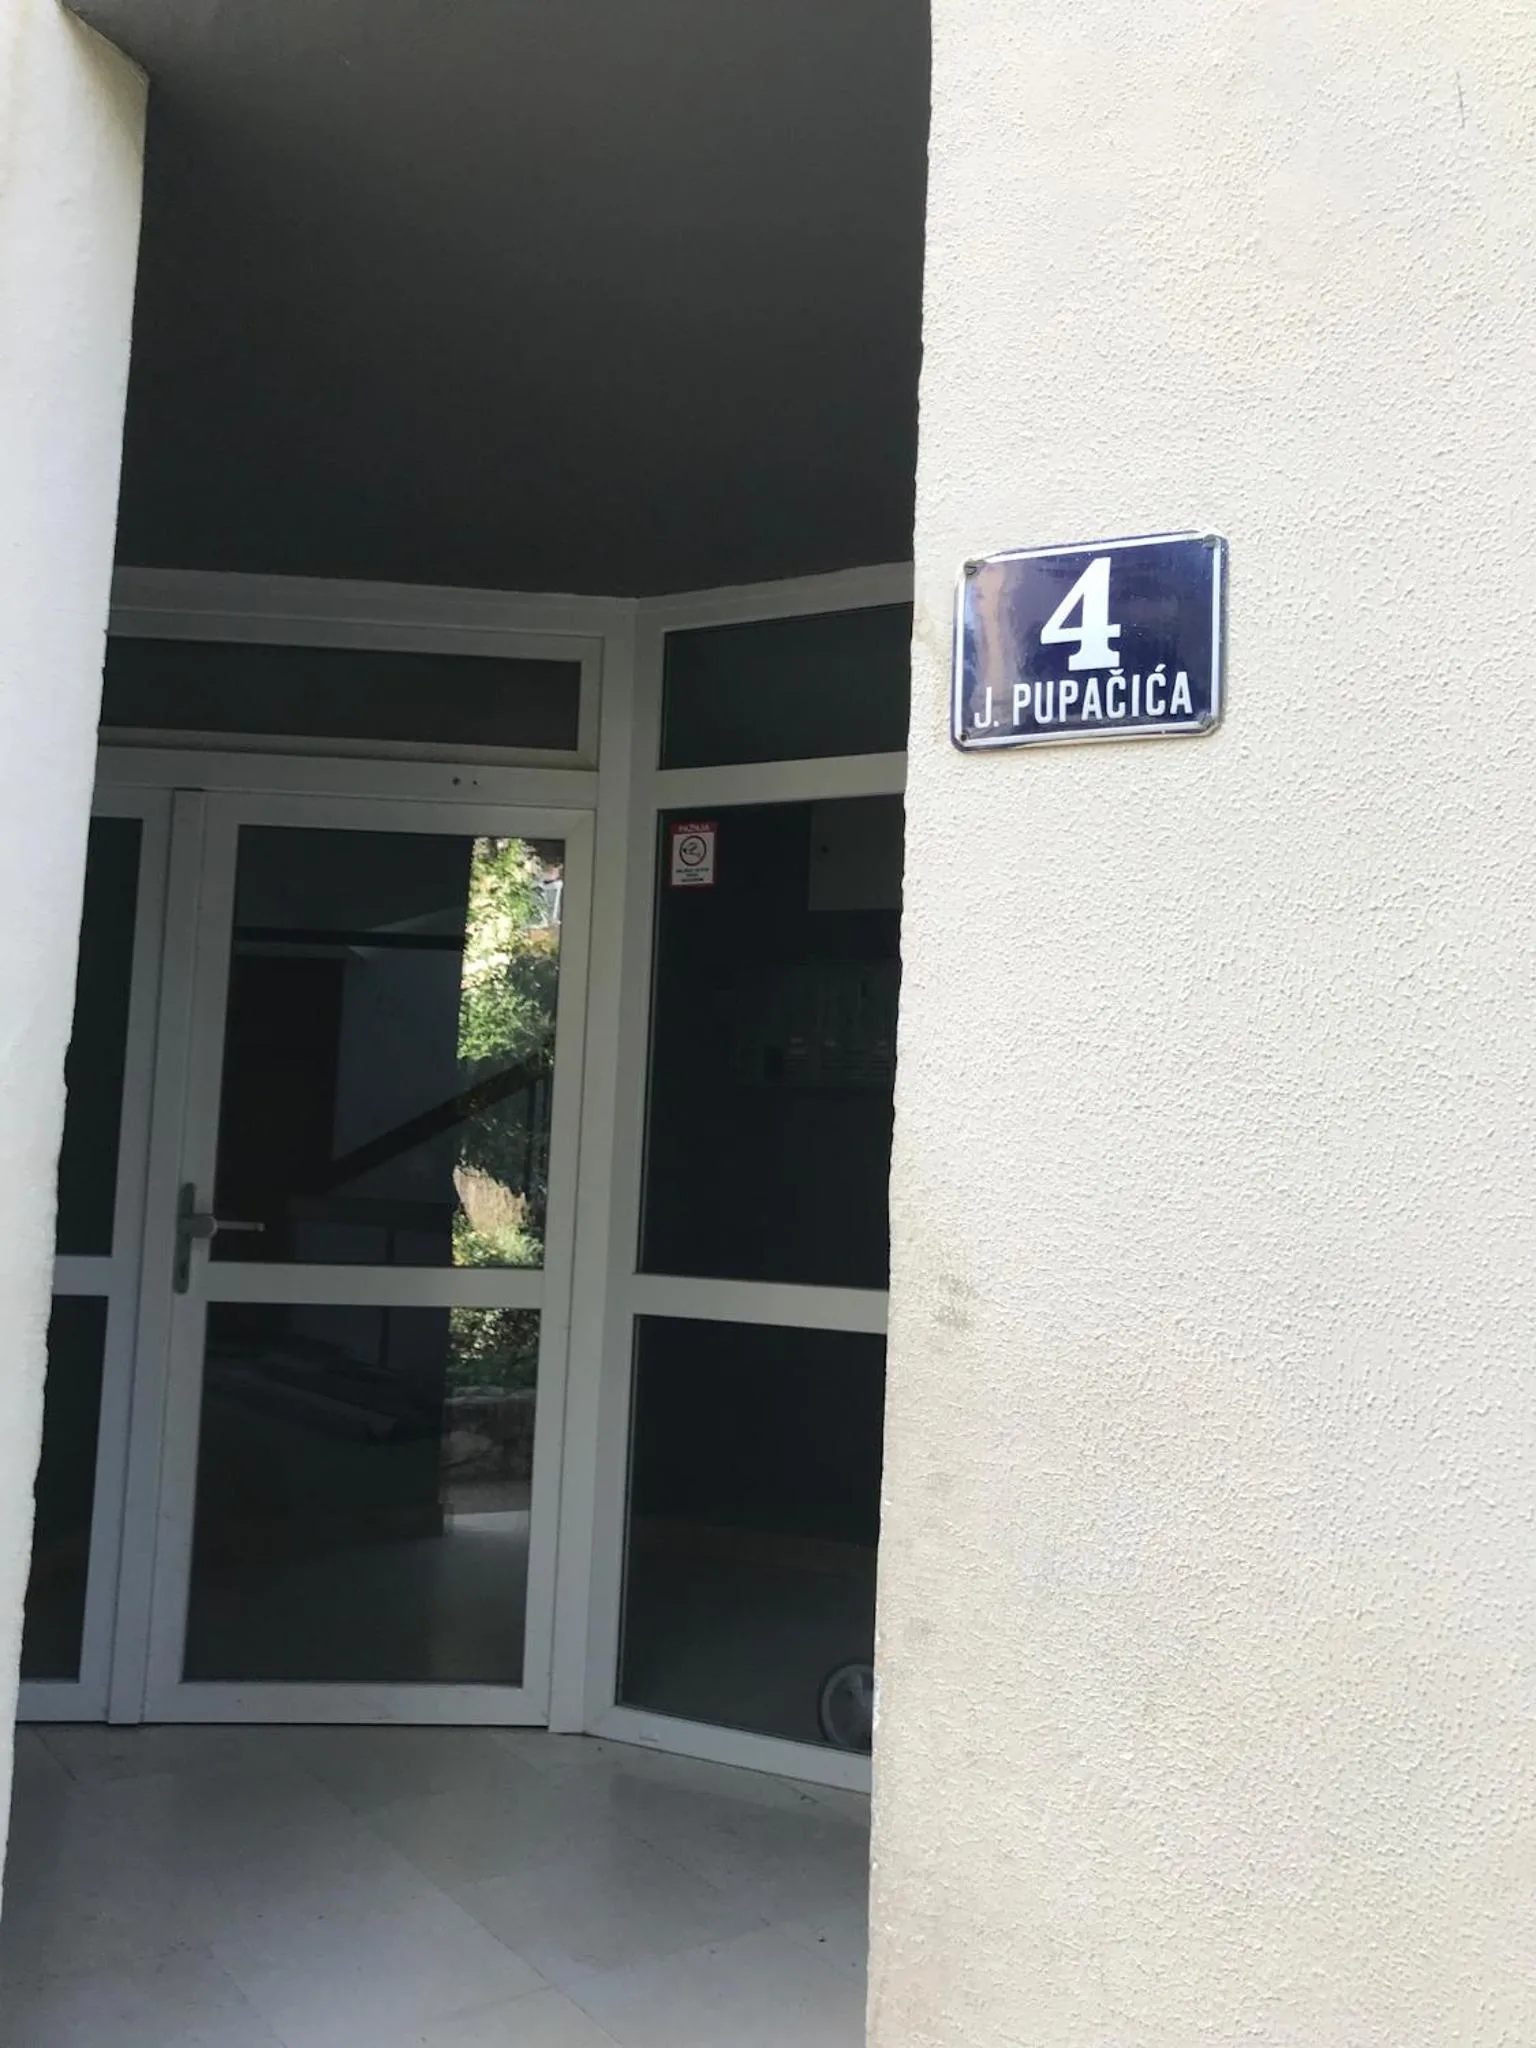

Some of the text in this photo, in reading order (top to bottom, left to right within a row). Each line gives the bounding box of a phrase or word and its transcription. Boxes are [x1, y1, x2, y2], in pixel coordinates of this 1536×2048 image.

[1040, 557, 1121, 671] 4
[974, 664, 1194, 729] J. PUPAČIĆA
